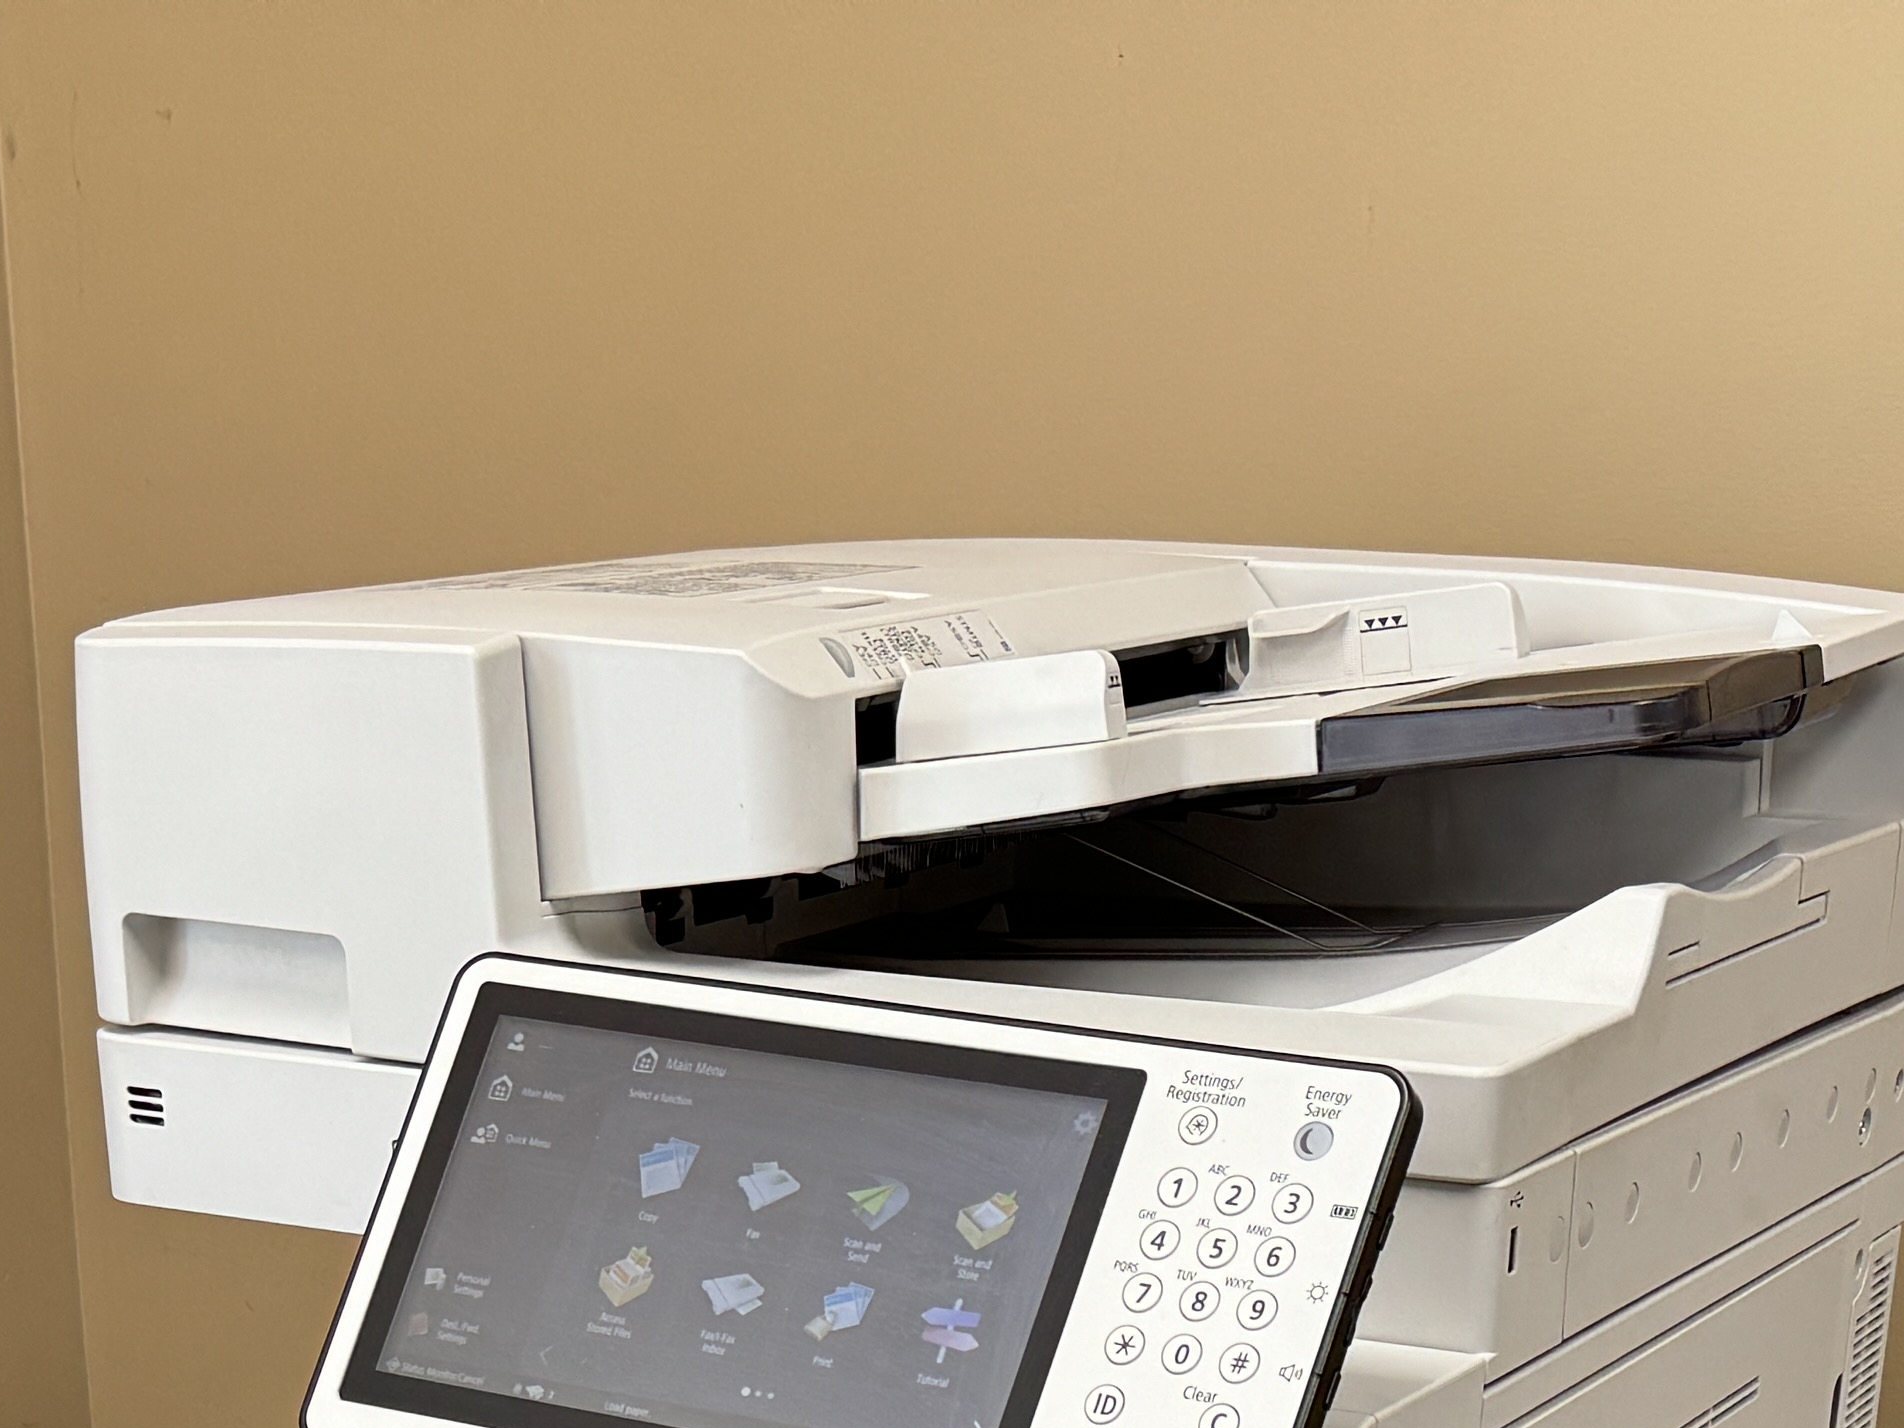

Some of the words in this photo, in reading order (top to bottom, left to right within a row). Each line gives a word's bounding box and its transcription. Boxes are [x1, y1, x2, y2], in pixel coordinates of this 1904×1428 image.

[666, 1057, 693, 1073] Main
[696, 1061, 727, 1078] Menu
[1182, 1069, 1244, 1091] Settings/
[521, 1087, 542, 1098] Main
[629, 1087, 652, 1101] Select
[1166, 1085, 1246, 1108] Registration
[1305, 1085, 1352, 1106] Energy
[1304, 1103, 1342, 1120] Saver
[505, 1133, 527, 1147] Quick
[528, 1137, 552, 1149] Menu
[1208, 1163, 1230, 1176] ABC
[1269, 1171, 1291, 1184] DEF
[1172, 1177, 1184, 1198] 1
[1225, 1185, 1242, 1206] 2
[1283, 1192, 1300, 1214] 3
[638, 1210, 659, 1225] Copy
[746, 1228, 760, 1240] Fax
[1246, 1224, 1273, 1237] MNO
[844, 1237, 863, 1250] Scan
[864, 1241, 882, 1253] and
[1150, 1230, 1167, 1251] 4
[1209, 1238, 1226, 1259] 5
[847, 1251, 870, 1264] Send
[953, 1255, 973, 1268] Scan
[974, 1258, 993, 1270] and
[1266, 1246, 1283, 1267] 6
[1114, 1259, 1139, 1273] PQRS
[456, 1272, 491, 1287] Personal
[957, 1269, 980, 1282] Store
[1177, 1268, 1197, 1281] TUV
[1225, 1276, 1254, 1290] WXYZ
[453, 1284, 484, 1299] Settings
[1136, 1282, 1152, 1303] 7
[1191, 1291, 1208, 1312] 8
[1249, 1299, 1265, 1320] 9
[599, 1312, 626, 1325] Access
[436, 1330, 467, 1346] Settings
[586, 1322, 613, 1337] Stored
[613, 1326, 632, 1340] Files
[812, 1355, 834, 1368] Print
[1175, 1344, 1190, 1365] 0
[400, 1362, 425, 1376] Status
[1230, 1352, 1250, 1374] #
[916, 1373, 950, 1388] Tutorial
[1183, 1385, 1218, 1403] Clear
[604, 1401, 624, 1413] Load
[1093, 1393, 1117, 1415] ID
